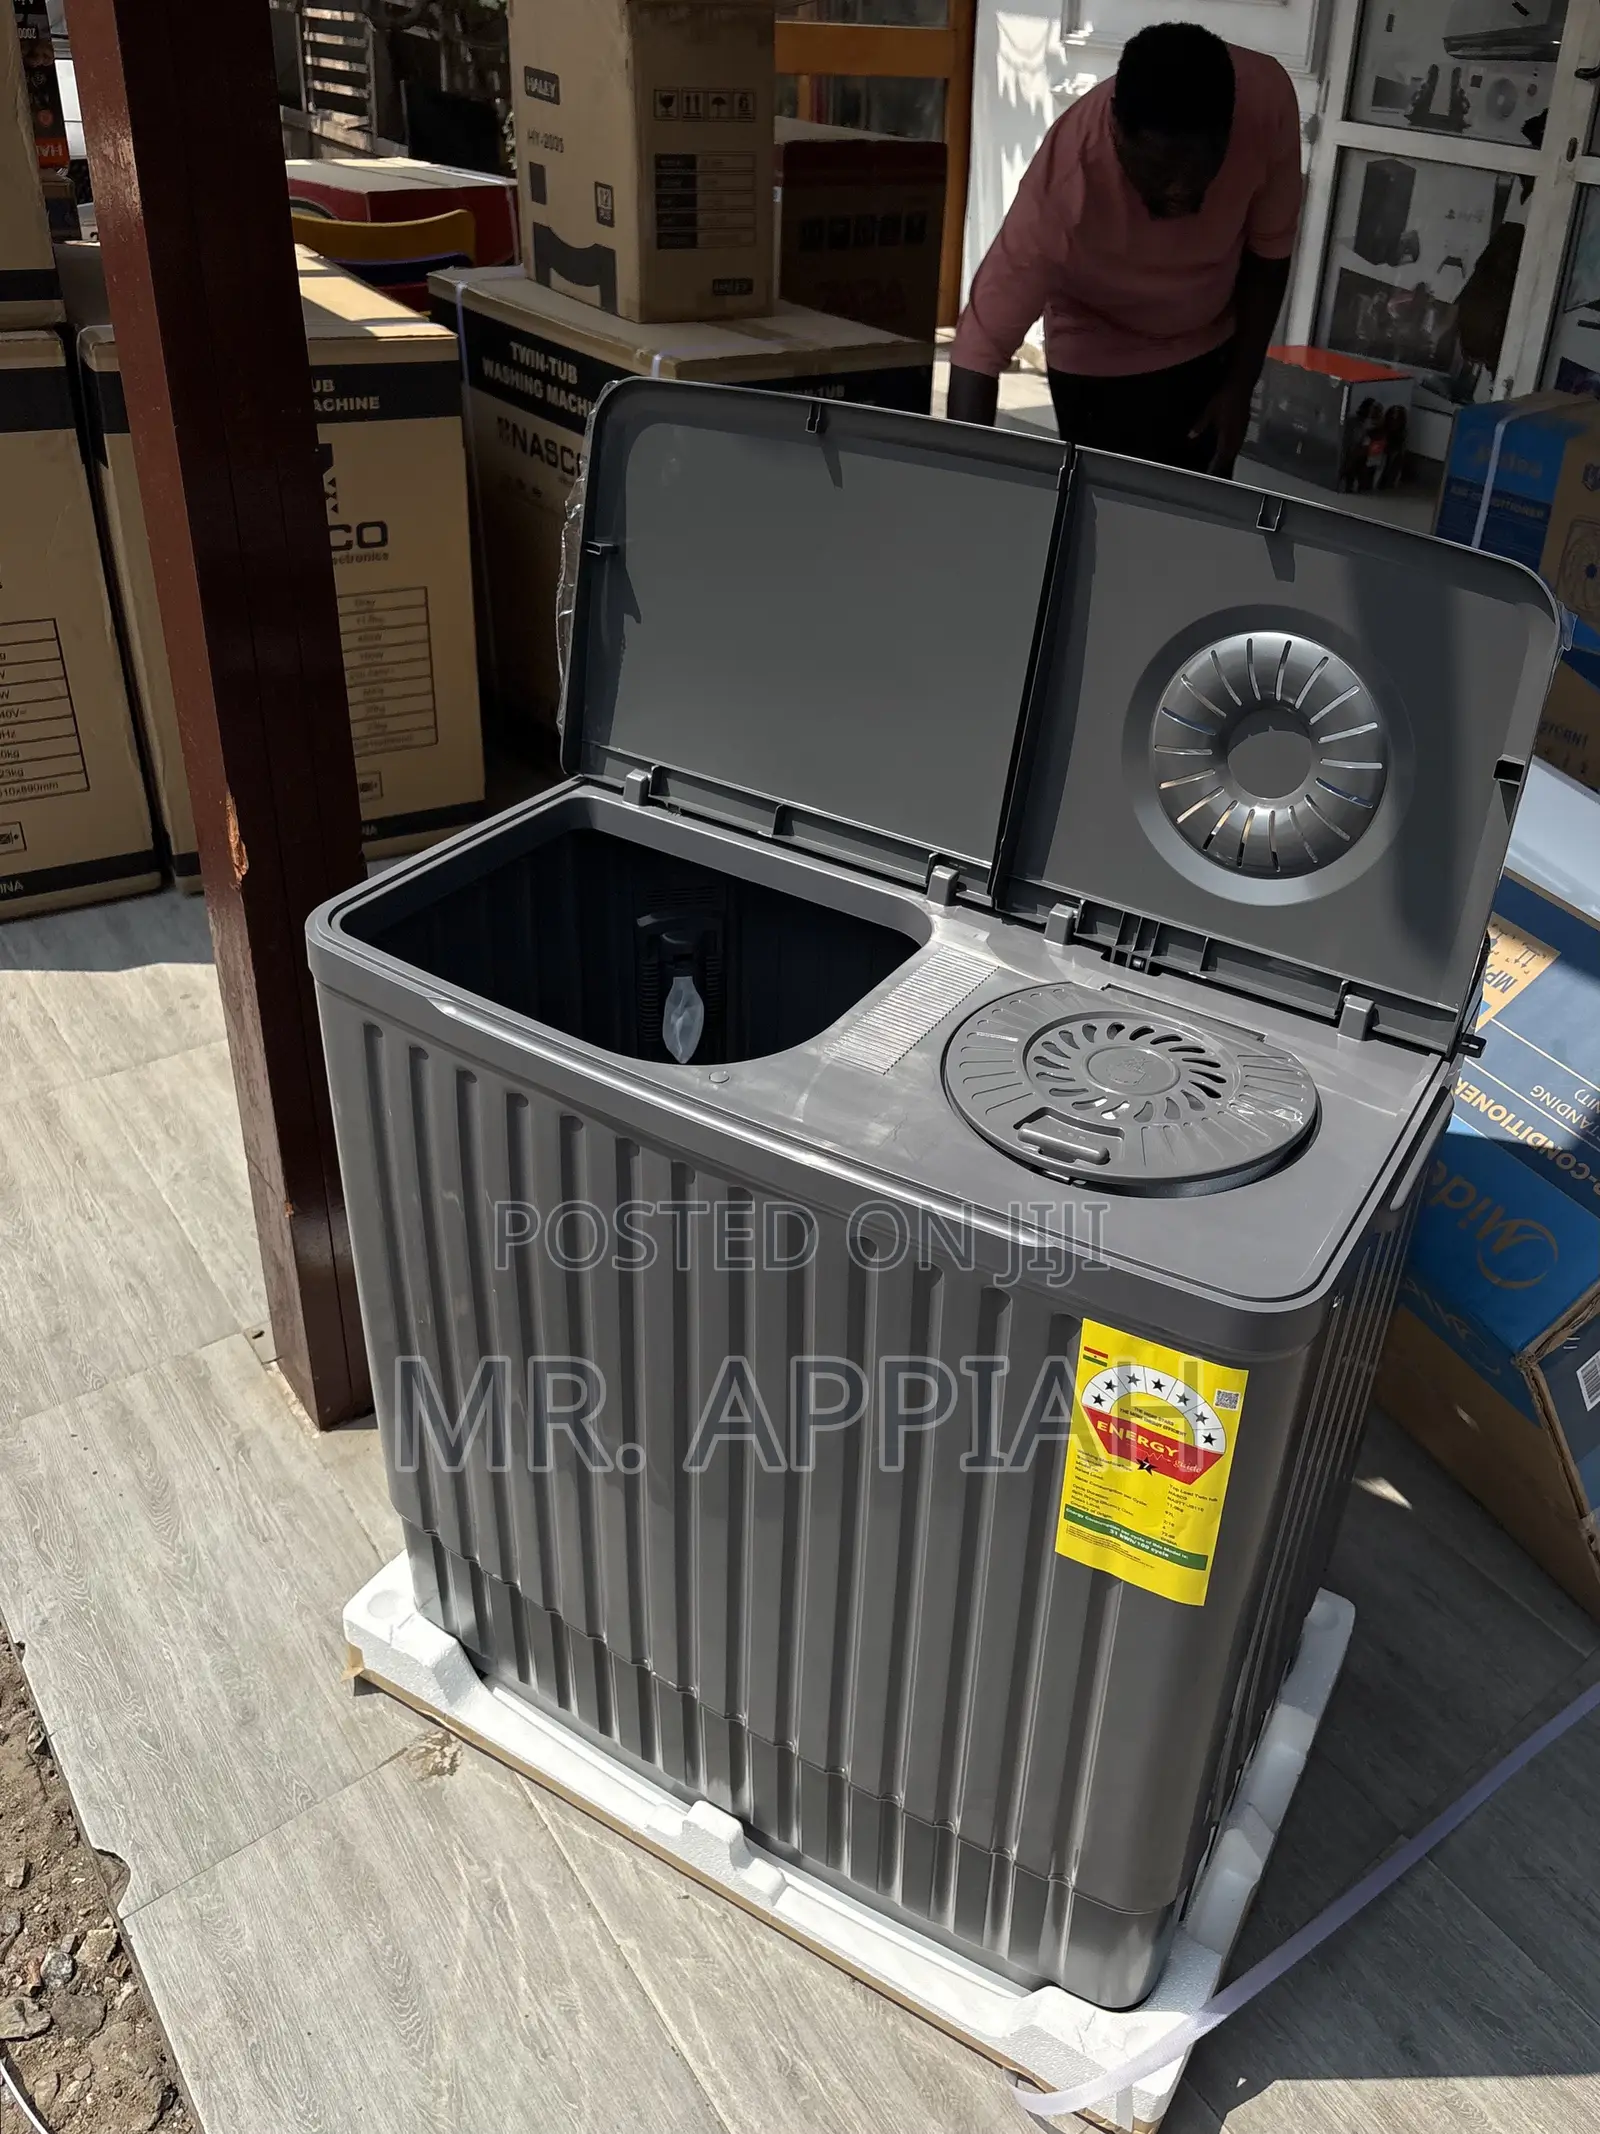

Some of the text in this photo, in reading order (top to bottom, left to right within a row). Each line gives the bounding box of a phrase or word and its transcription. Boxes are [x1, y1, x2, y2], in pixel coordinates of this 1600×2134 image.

[482, 356, 544, 399] WASHING
[509, 341, 578, 385] TWIN-TUB
[512, 421, 582, 477] NASC
[1096, 1419, 1180, 1456] ENERGY
[1143, 1461, 1150, 1469] 7
[1173, 1459, 1203, 1474] guide
[1150, 1547, 1169, 1558] cycle
